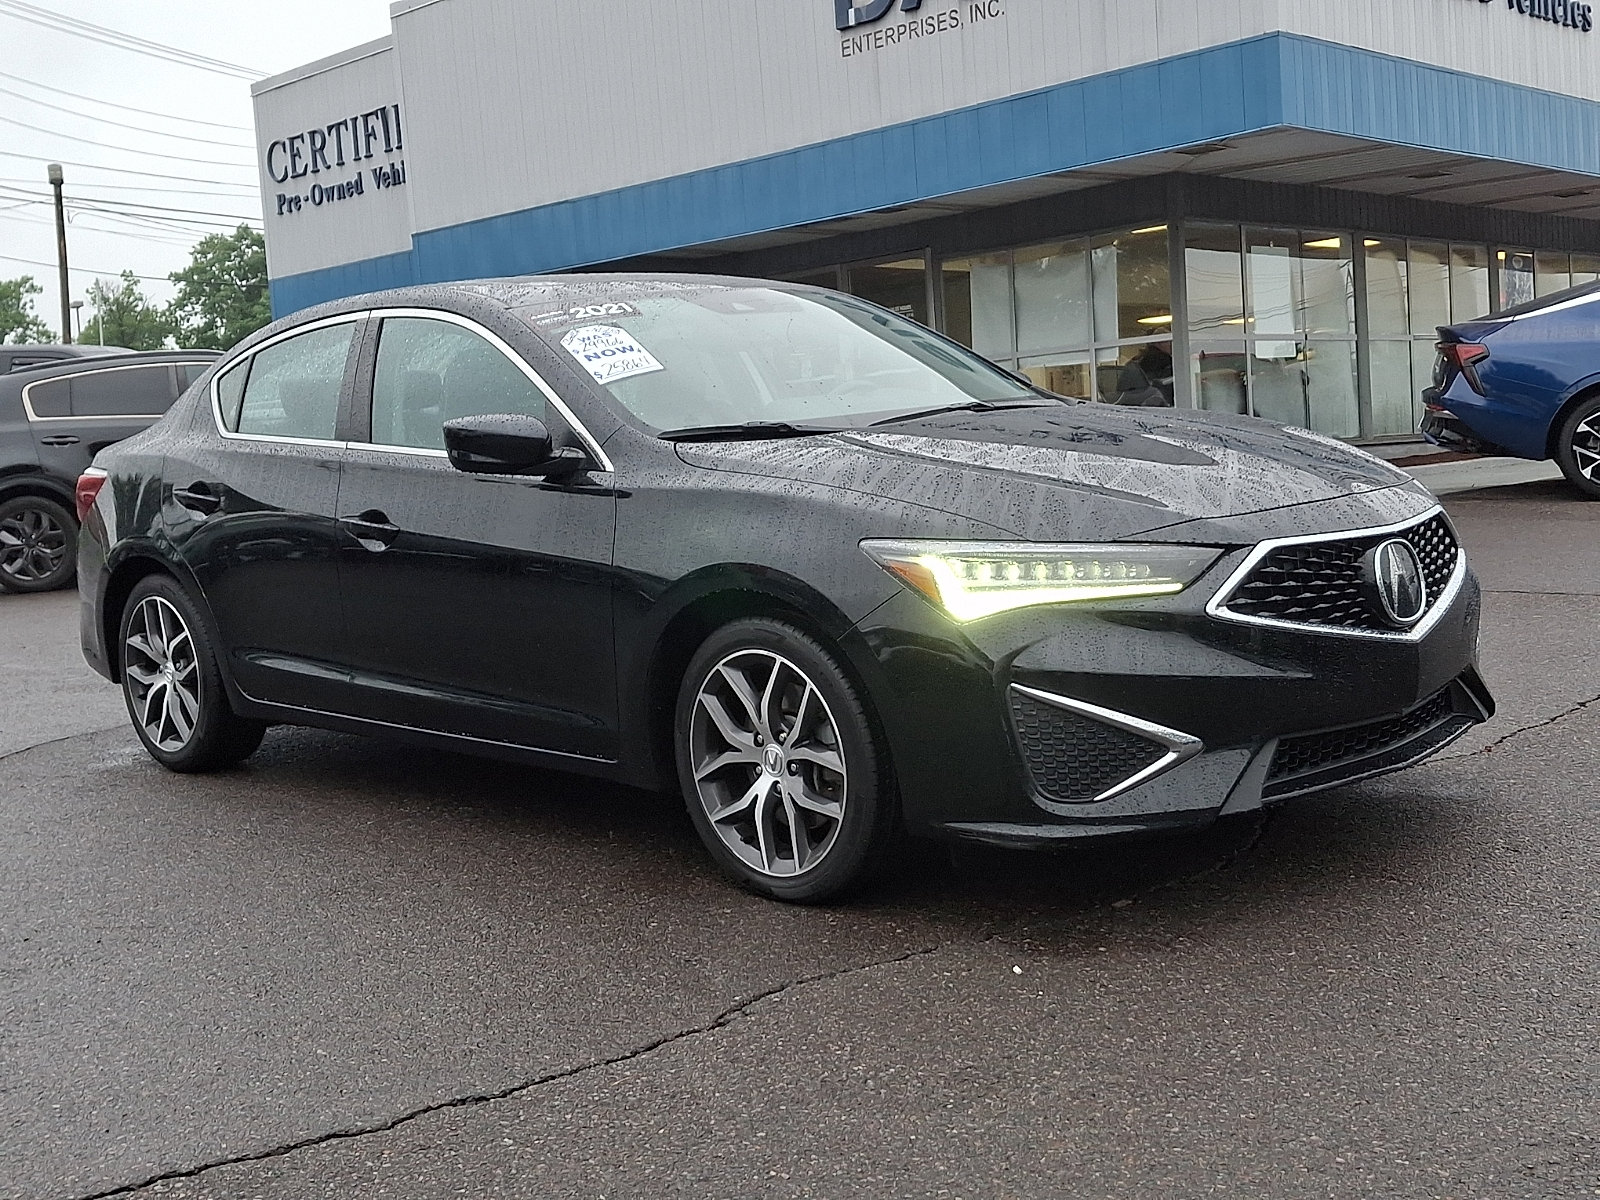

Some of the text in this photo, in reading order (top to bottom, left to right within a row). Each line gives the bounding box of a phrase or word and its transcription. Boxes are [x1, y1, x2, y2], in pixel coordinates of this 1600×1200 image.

[840, 9, 964, 58] ENTERPRISES,
[969, 0, 1005, 24] INC.
[276, 171, 364, 216] Pre-Owned
[569, 302, 634, 319] 2021
[584, 345, 635, 362] NOW
